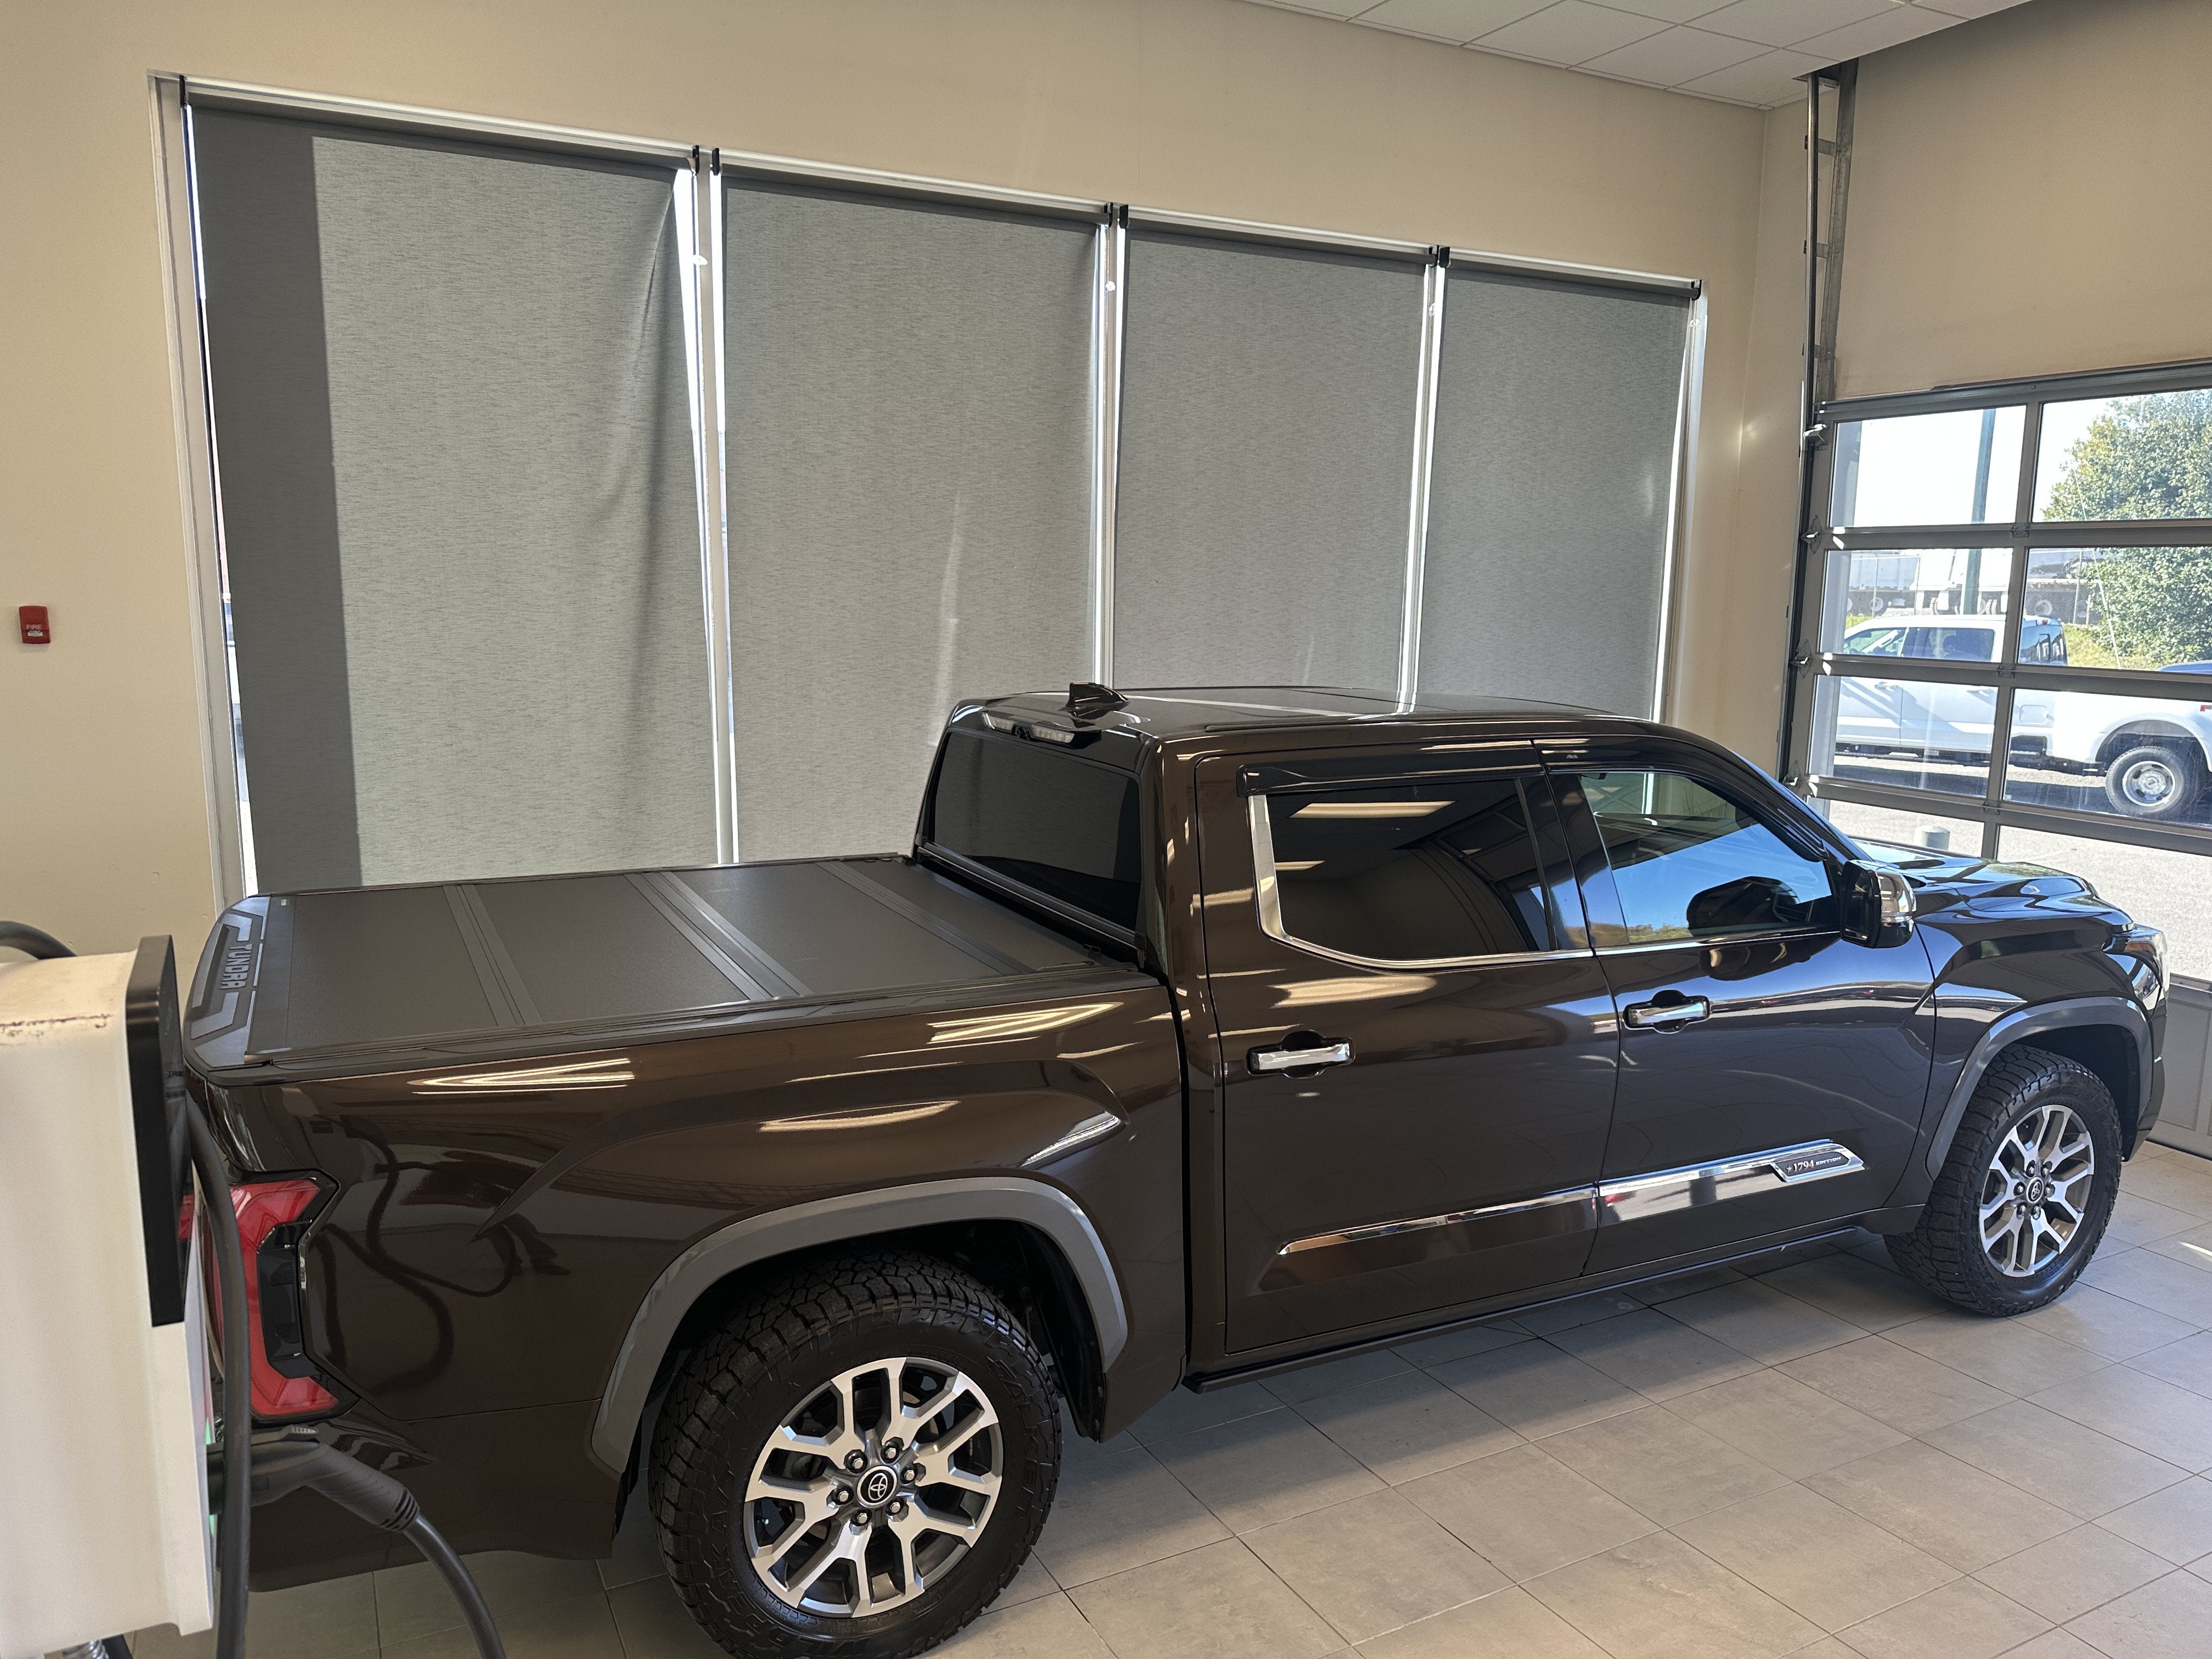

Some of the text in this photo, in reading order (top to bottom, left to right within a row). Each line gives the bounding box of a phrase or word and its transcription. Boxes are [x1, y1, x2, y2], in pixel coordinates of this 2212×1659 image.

[220, 943, 253, 990] TUNDRA
[1793, 1156, 1842, 1173] 1794 EDITION
